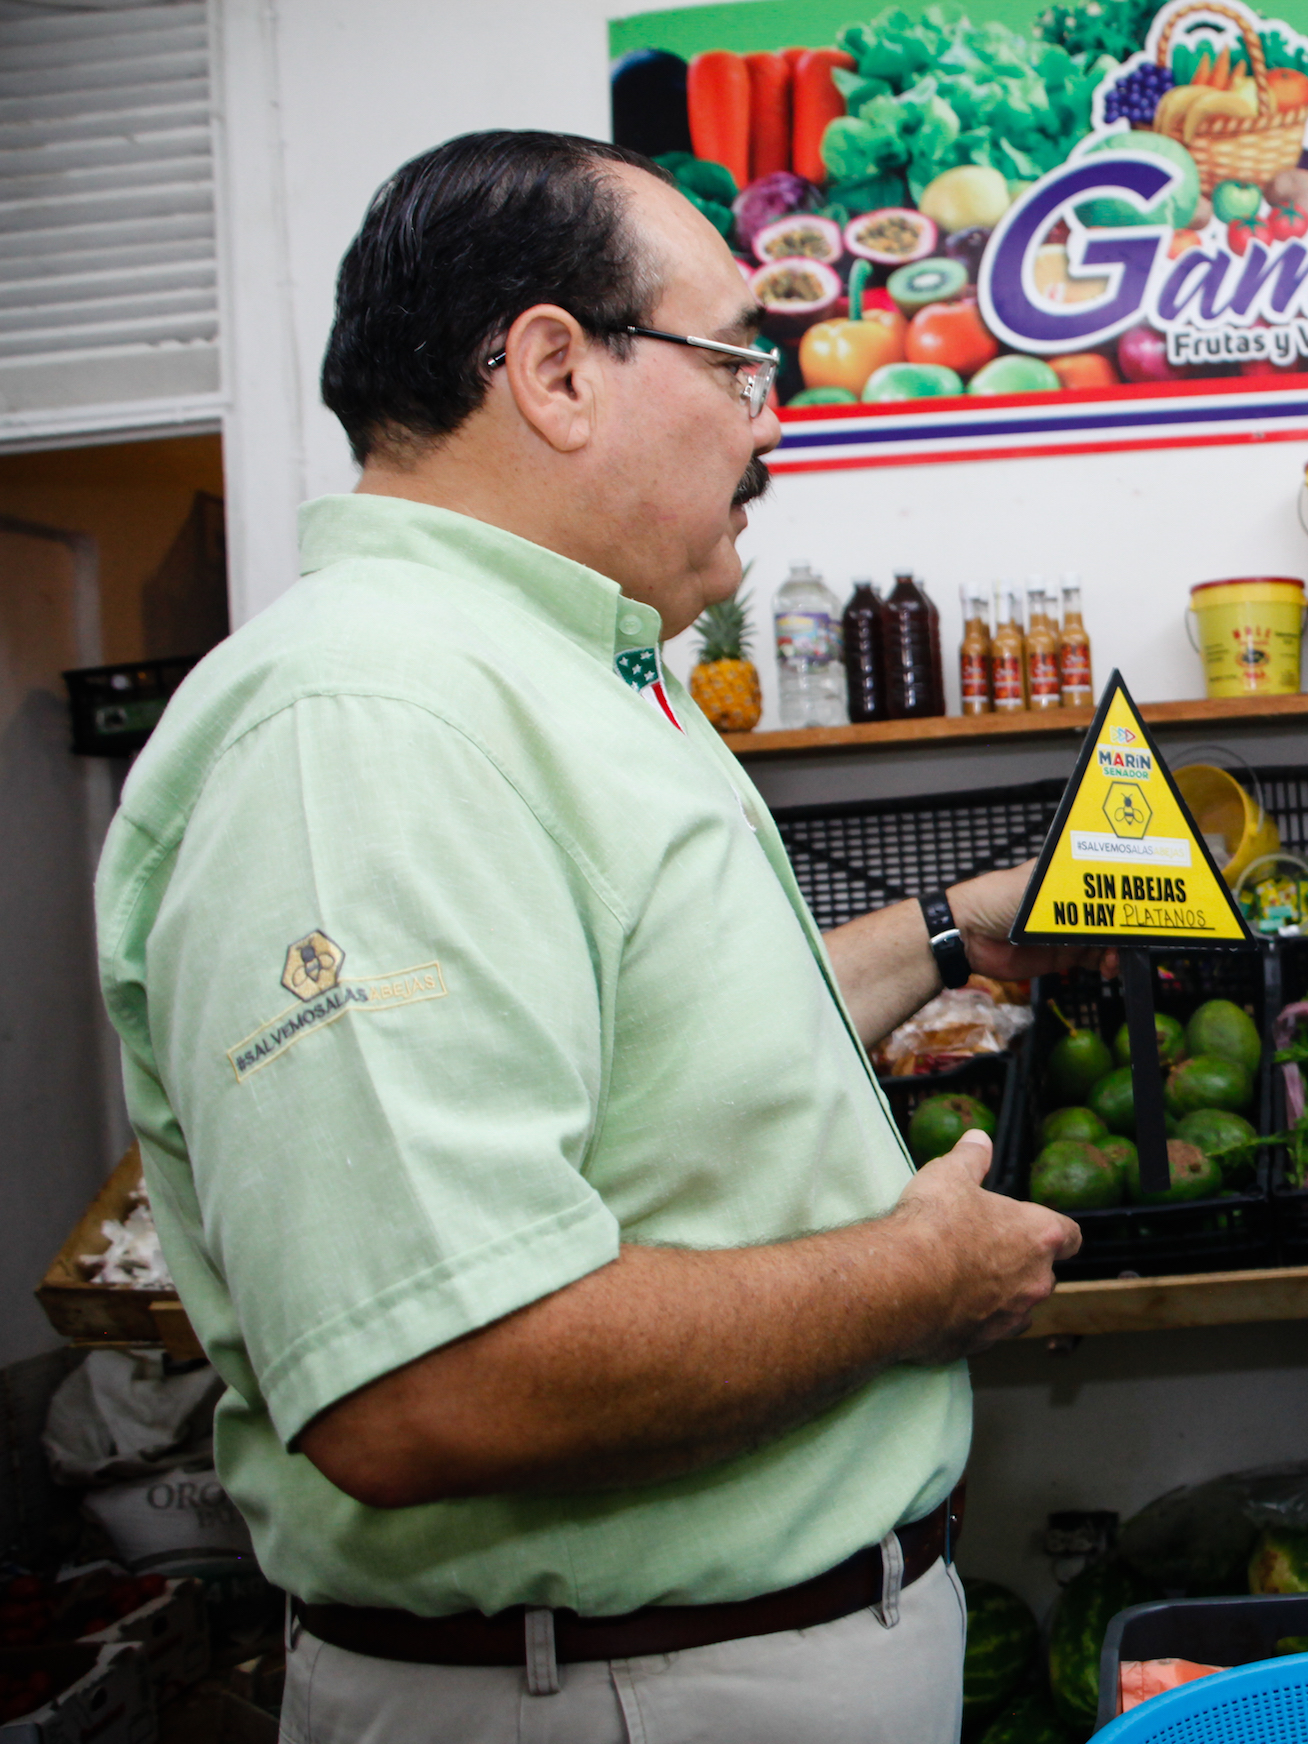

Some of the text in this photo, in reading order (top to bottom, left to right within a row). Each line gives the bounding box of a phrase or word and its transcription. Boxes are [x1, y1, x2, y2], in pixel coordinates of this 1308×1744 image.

[1174, 329, 1266, 359] Frutas
[1274, 334, 1295, 360] y
[1103, 766, 1149, 780] SENADOR
[1083, 872, 1187, 903] SIN ABEJAS
[1053, 900, 1116, 927] NO HAY
[1122, 903, 1207, 928] PLATANOS
